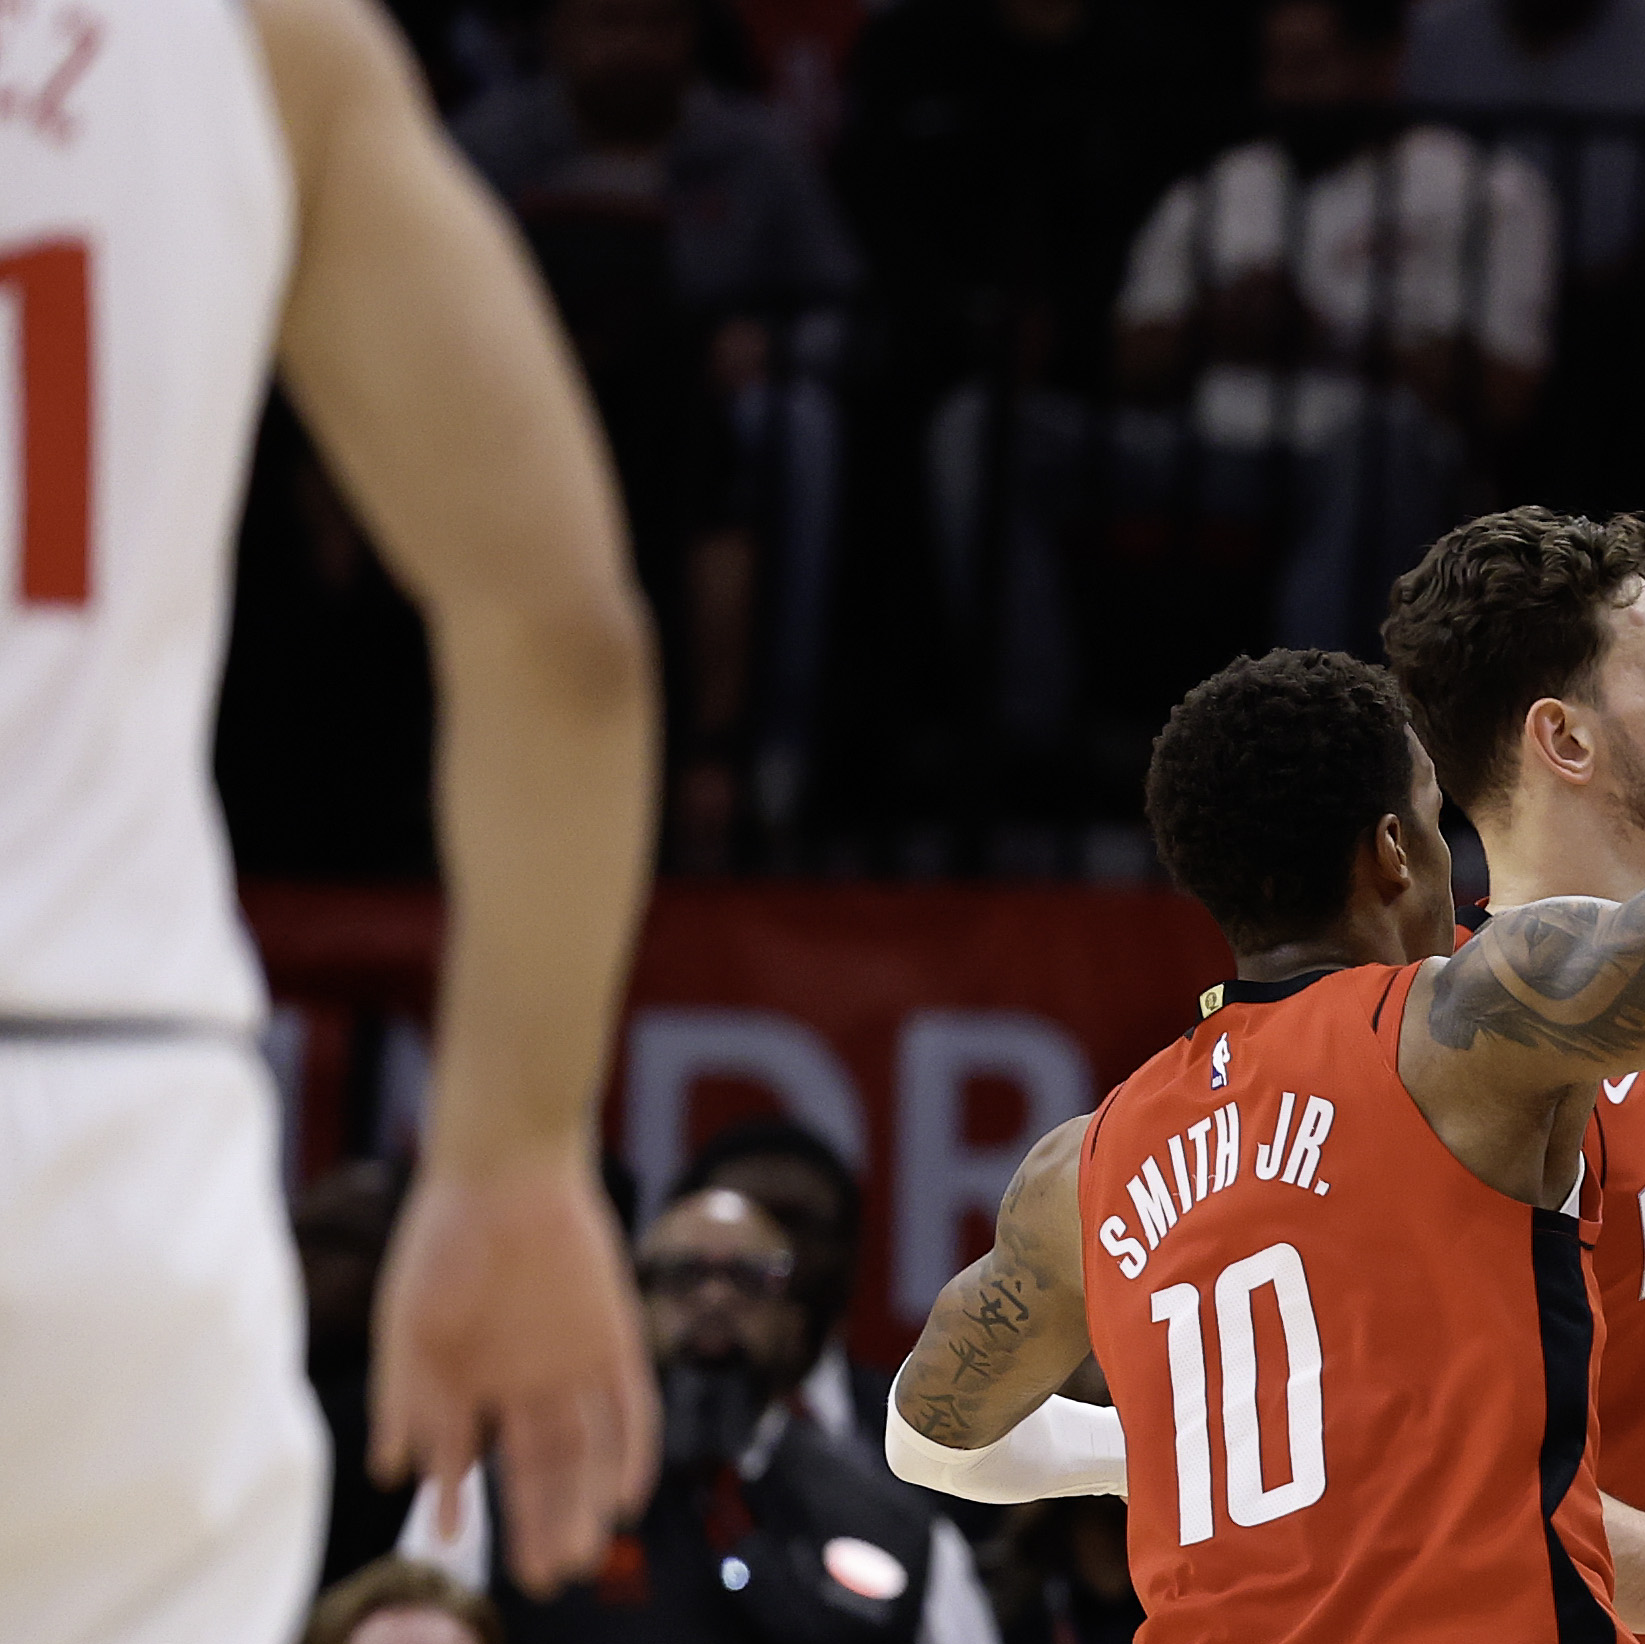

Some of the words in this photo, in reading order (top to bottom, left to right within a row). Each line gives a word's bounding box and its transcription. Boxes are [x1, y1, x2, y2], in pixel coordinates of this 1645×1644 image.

[1099, 1101, 1241, 1280] SMITH
[1255, 1091, 1336, 1197] JR.
[1150, 1242, 1327, 1547] 10
